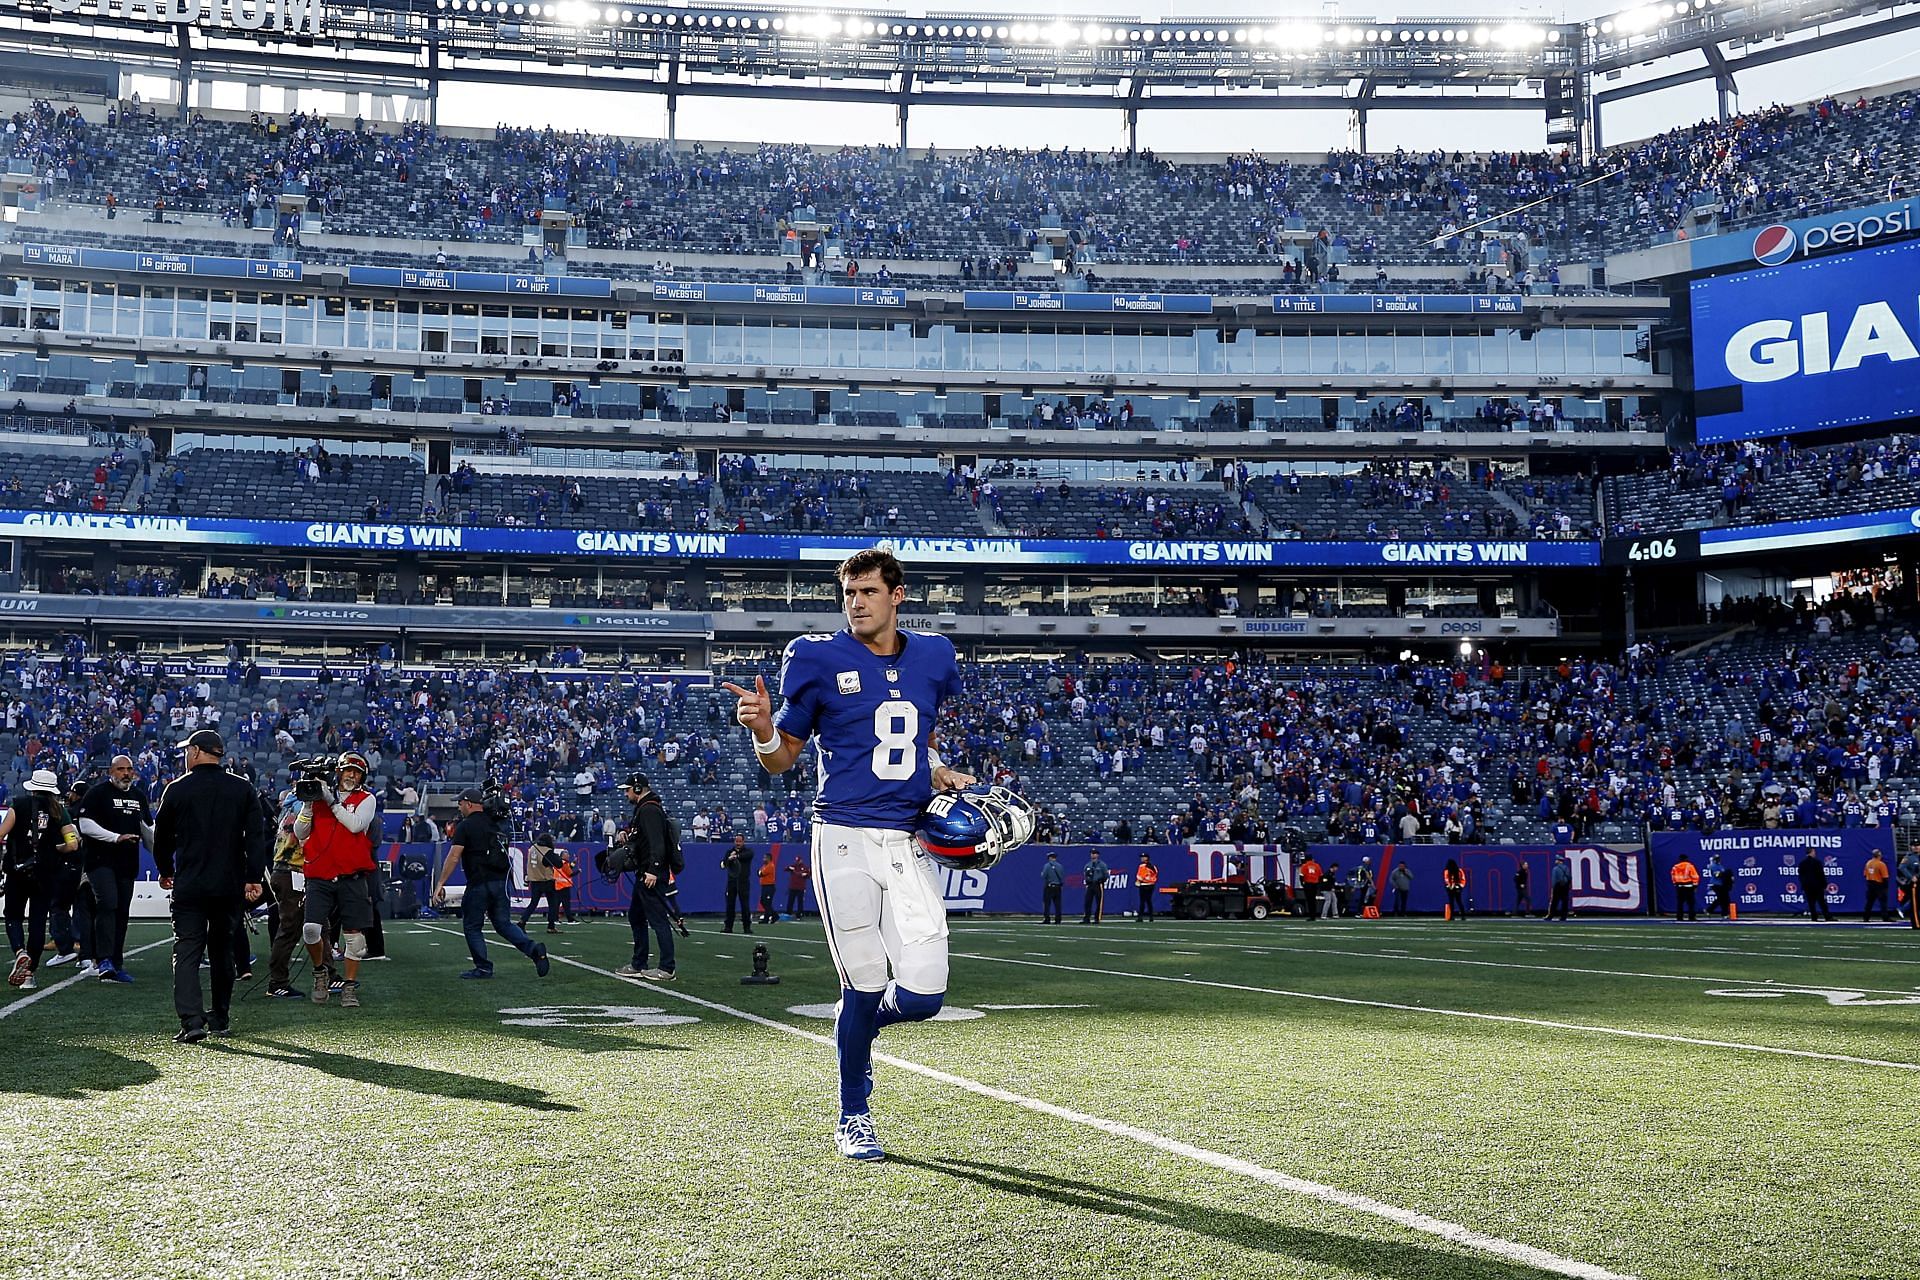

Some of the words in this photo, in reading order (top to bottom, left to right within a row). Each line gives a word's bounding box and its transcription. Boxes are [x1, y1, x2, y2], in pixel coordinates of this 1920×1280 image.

[1803, 204, 1911, 256] pepsi
[48, 253, 73, 265] MARA
[141, 257, 152, 267] 16
[154, 261, 187, 272] GIFFORD
[271, 268, 294, 279] TISCH
[419, 277, 450, 288] HOWELL
[516, 278, 528, 288] 70
[530, 282, 550, 293] HUFF
[655, 285, 667, 295] 29
[667, 289, 703, 299] WEBSTER
[756, 288, 766, 298] 81
[766, 291, 804, 302] ROBUSTELLI
[861, 292, 874, 301] 22
[876, 295, 899, 305] LYNCH
[1028, 298, 1061, 309] JOHNSON
[1114, 297, 1125, 307] 40
[1125, 300, 1162, 310] MORRISON
[1280, 299, 1290, 308] 14
[1293, 302, 1316, 311] TITTLE
[1376, 299, 1383, 308] 3
[1385, 301, 1418, 311] GOGOLAK
[1494, 301, 1516, 311] MARA
[1725, 295, 1920, 383] GIA
[23, 513, 128, 529] GIANTS
[133, 516, 187, 532] WIN
[306, 524, 405, 546] GIANTS
[408, 527, 462, 547] WIN
[576, 533, 671, 553] GIANTS
[675, 535, 726, 554] WIN
[875, 539, 967, 553] GIANTS
[973, 541, 1021, 553] WIN
[1128, 543, 1219, 561] GIANTS
[1224, 544, 1273, 562] WIN
[1381, 544, 1474, 562] GIANTS
[1477, 544, 1527, 562] WIN
[1629, 538, 1677, 561] 4:06
[291, 609, 370, 619] MetLife
[595, 616, 670, 627] MetLife
[1245, 622, 1272, 632] BUD
[1273, 622, 1306, 632] LIGHT
[1440, 620, 1482, 634] pepsi
[871, 700, 919, 781] 8
[1848, 805, 1860, 815] 56
[1878, 807, 1889, 817] 56
[767, 821, 778, 833] 56
[792, 821, 802, 831] 21
[1365, 828, 1375, 838] 10
[1700, 836, 1750, 850] WORLD
[1753, 834, 1842, 849] CHAMPIONS
[1738, 867, 1763, 876] 2007
[1823, 867, 1843, 876] 986
[1564, 848, 1641, 910] ny
[1740, 895, 1764, 904] 1938
[1780, 894, 1804, 904] 1934
[1825, 895, 1846, 904] 927
